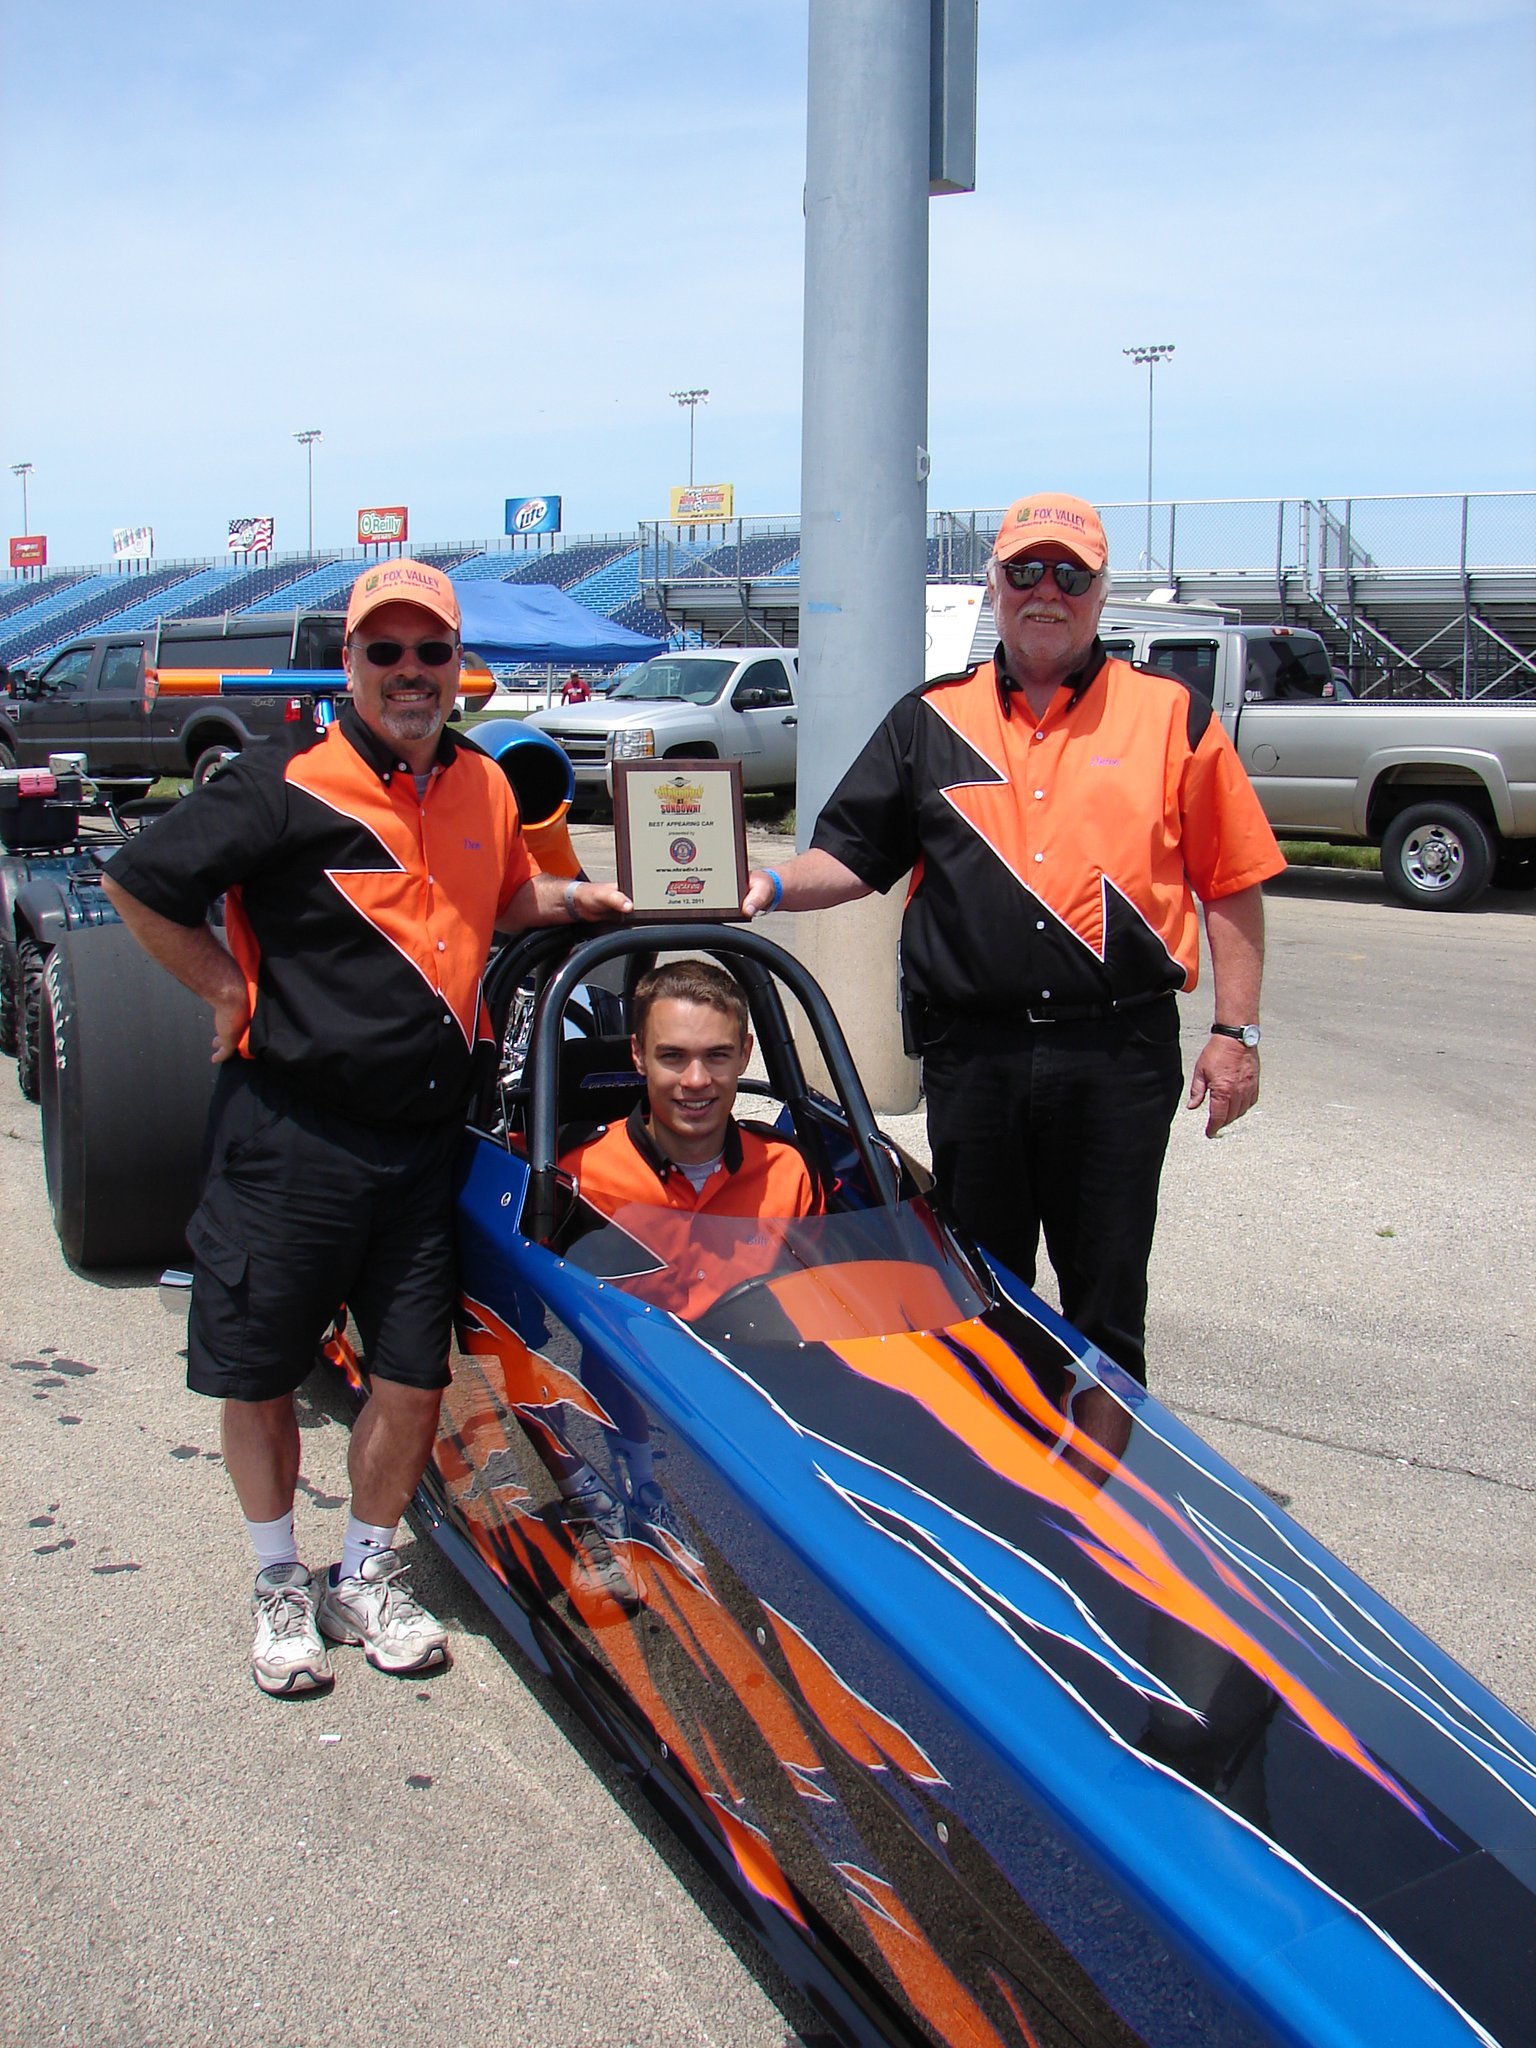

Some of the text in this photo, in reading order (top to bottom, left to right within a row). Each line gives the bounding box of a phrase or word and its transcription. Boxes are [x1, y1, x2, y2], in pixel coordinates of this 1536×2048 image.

[361, 514, 400, 533] O'Reilly
[519, 506, 544, 530] Lite
[1033, 508, 1086, 528] FOX VALLEY
[382, 569, 440, 588] FOX VALLEY
